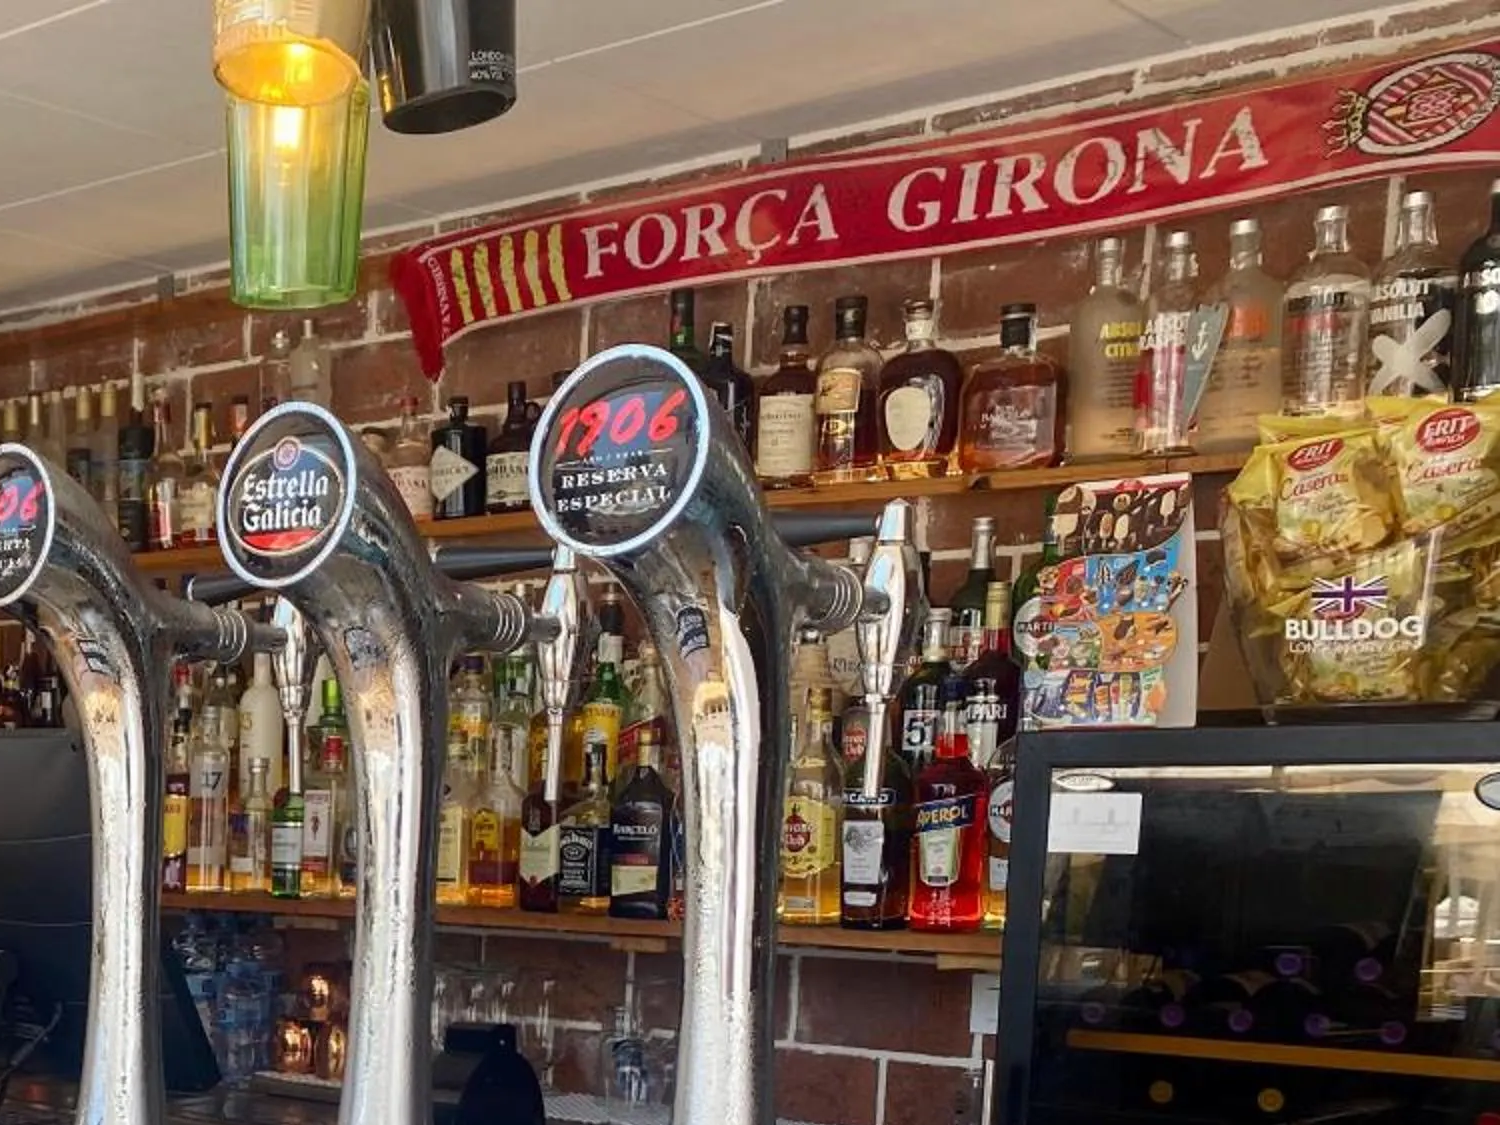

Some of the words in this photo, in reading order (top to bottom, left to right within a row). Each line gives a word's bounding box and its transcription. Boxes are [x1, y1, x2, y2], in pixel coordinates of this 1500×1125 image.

[581, 183, 839, 280] FORÇA
[886, 105, 1269, 233] GIRONA
[554, 388, 688, 457] 1906
[1423, 415, 1473, 438] FRIT
[241, 470, 329, 502] Estrella
[561, 463, 668, 489] RESERVA
[557, 485, 671, 512] ESPECIAL
[243, 499, 322, 532] Galicia
[1284, 614, 1425, 641] BULLDOG
[917, 804, 969, 827] APEROL
